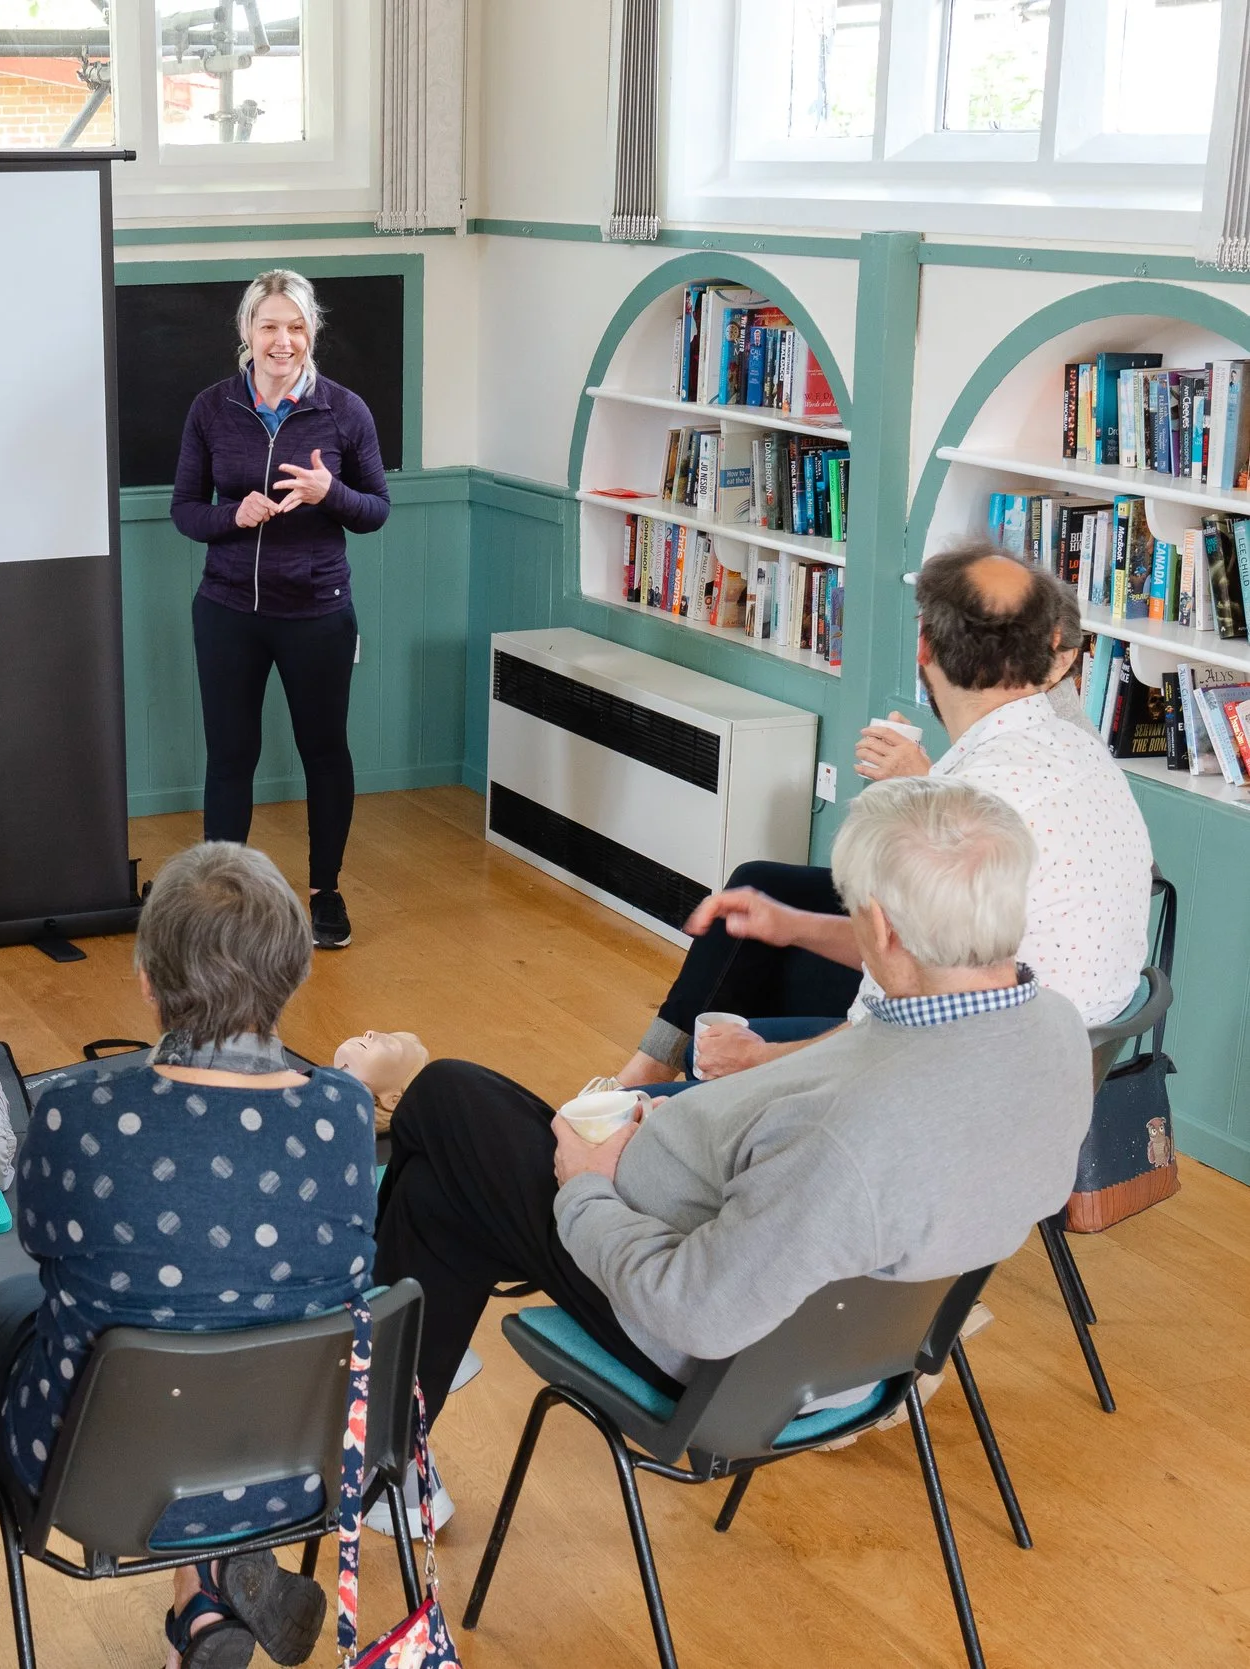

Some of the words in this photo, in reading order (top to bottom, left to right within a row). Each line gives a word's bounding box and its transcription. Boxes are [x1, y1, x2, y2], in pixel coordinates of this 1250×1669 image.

[1182, 396, 1192, 428] Cleeves
[700, 462, 708, 471] JO
[792, 478, 797, 487] ME
[677, 527, 685, 559] chris
[1033, 549, 1039, 558] OF
[1117, 526, 1125, 562] MacBook
[1184, 531, 1195, 567] WILLIAM
[1238, 538, 1246, 556] LEE
[701, 555, 709, 574] PAUL
[1154, 541, 1167, 585] CANADA
[1241, 556, 1250, 587] CHILD
[672, 569, 682, 606] evans
[1182, 570, 1193, 592] BOYD
[697, 578, 706, 612] O'GRADY
[1179, 668, 1187, 688] ALYS
[1205, 668, 1234, 682] ALYS
[1181, 688, 1189, 712] CLARE
[1132, 739, 1147, 753] THE
